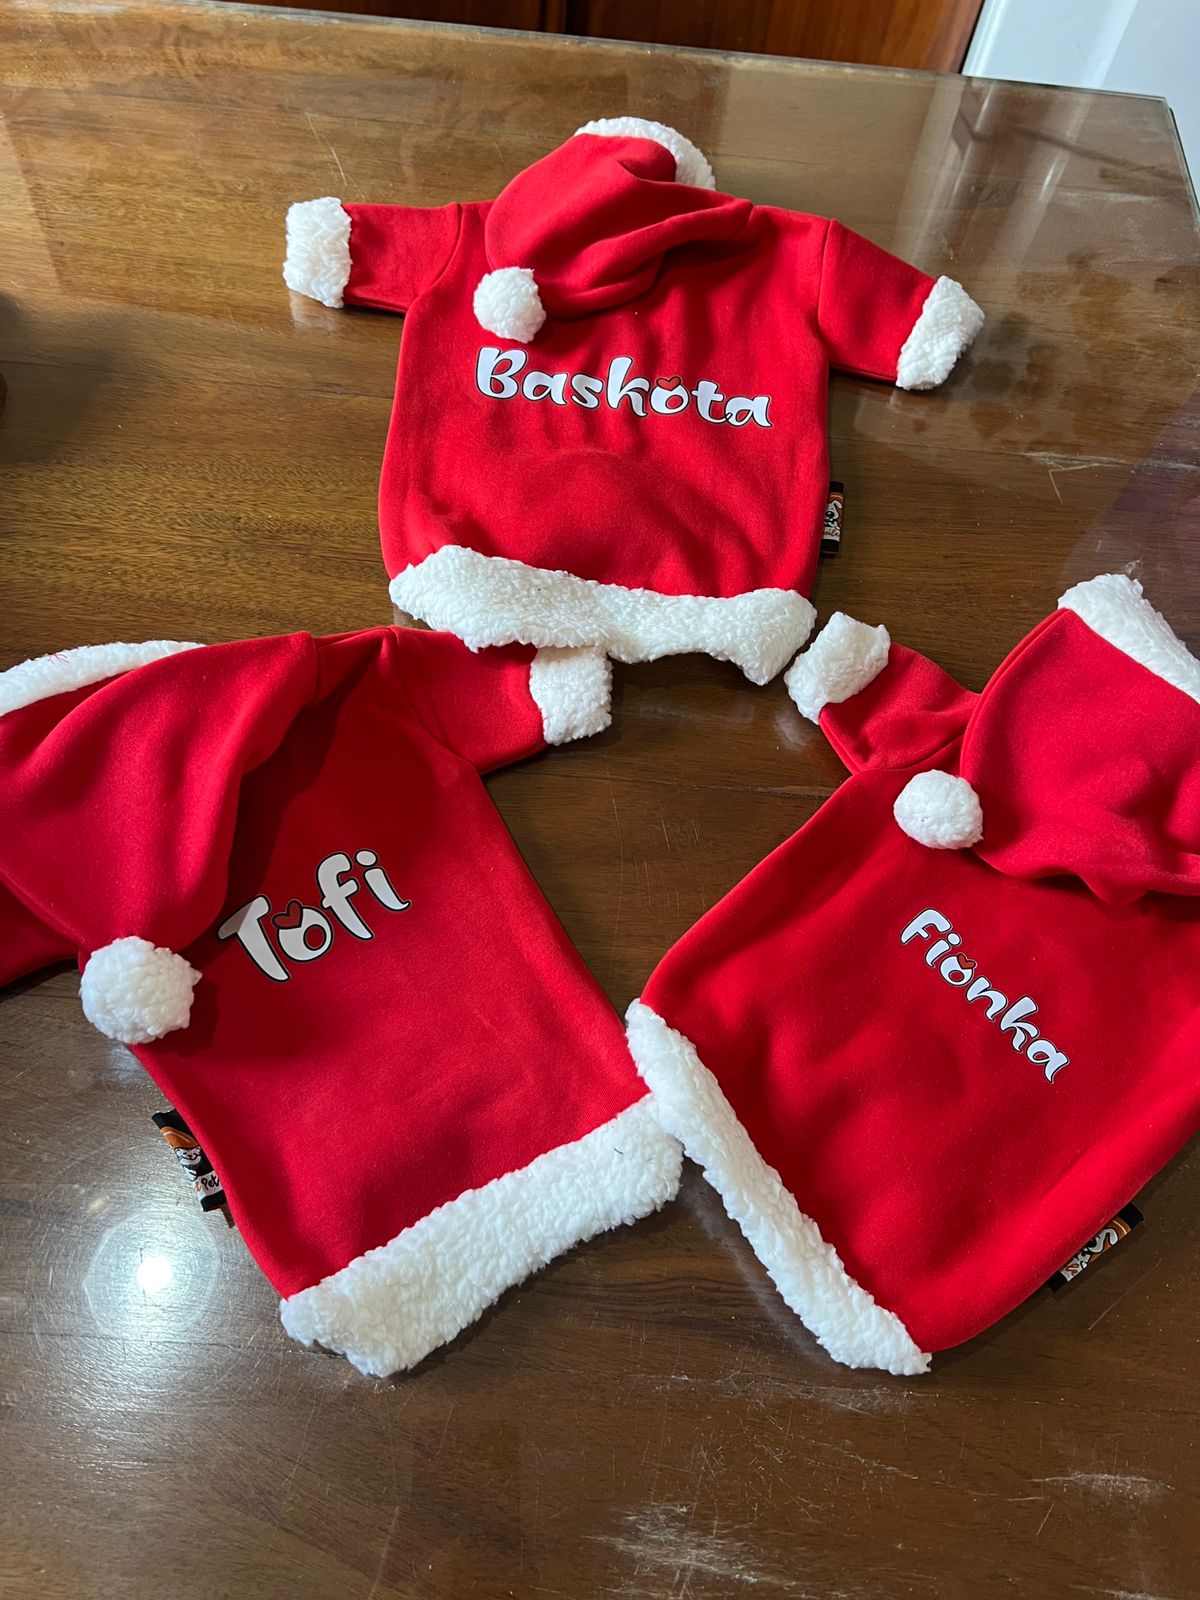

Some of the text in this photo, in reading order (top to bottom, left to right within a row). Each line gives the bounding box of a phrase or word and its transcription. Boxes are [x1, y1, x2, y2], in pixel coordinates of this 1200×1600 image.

[475, 346, 774, 428] Baskota
[217, 848, 412, 982] Tofi
[899, 907, 1070, 1084] Fionka
